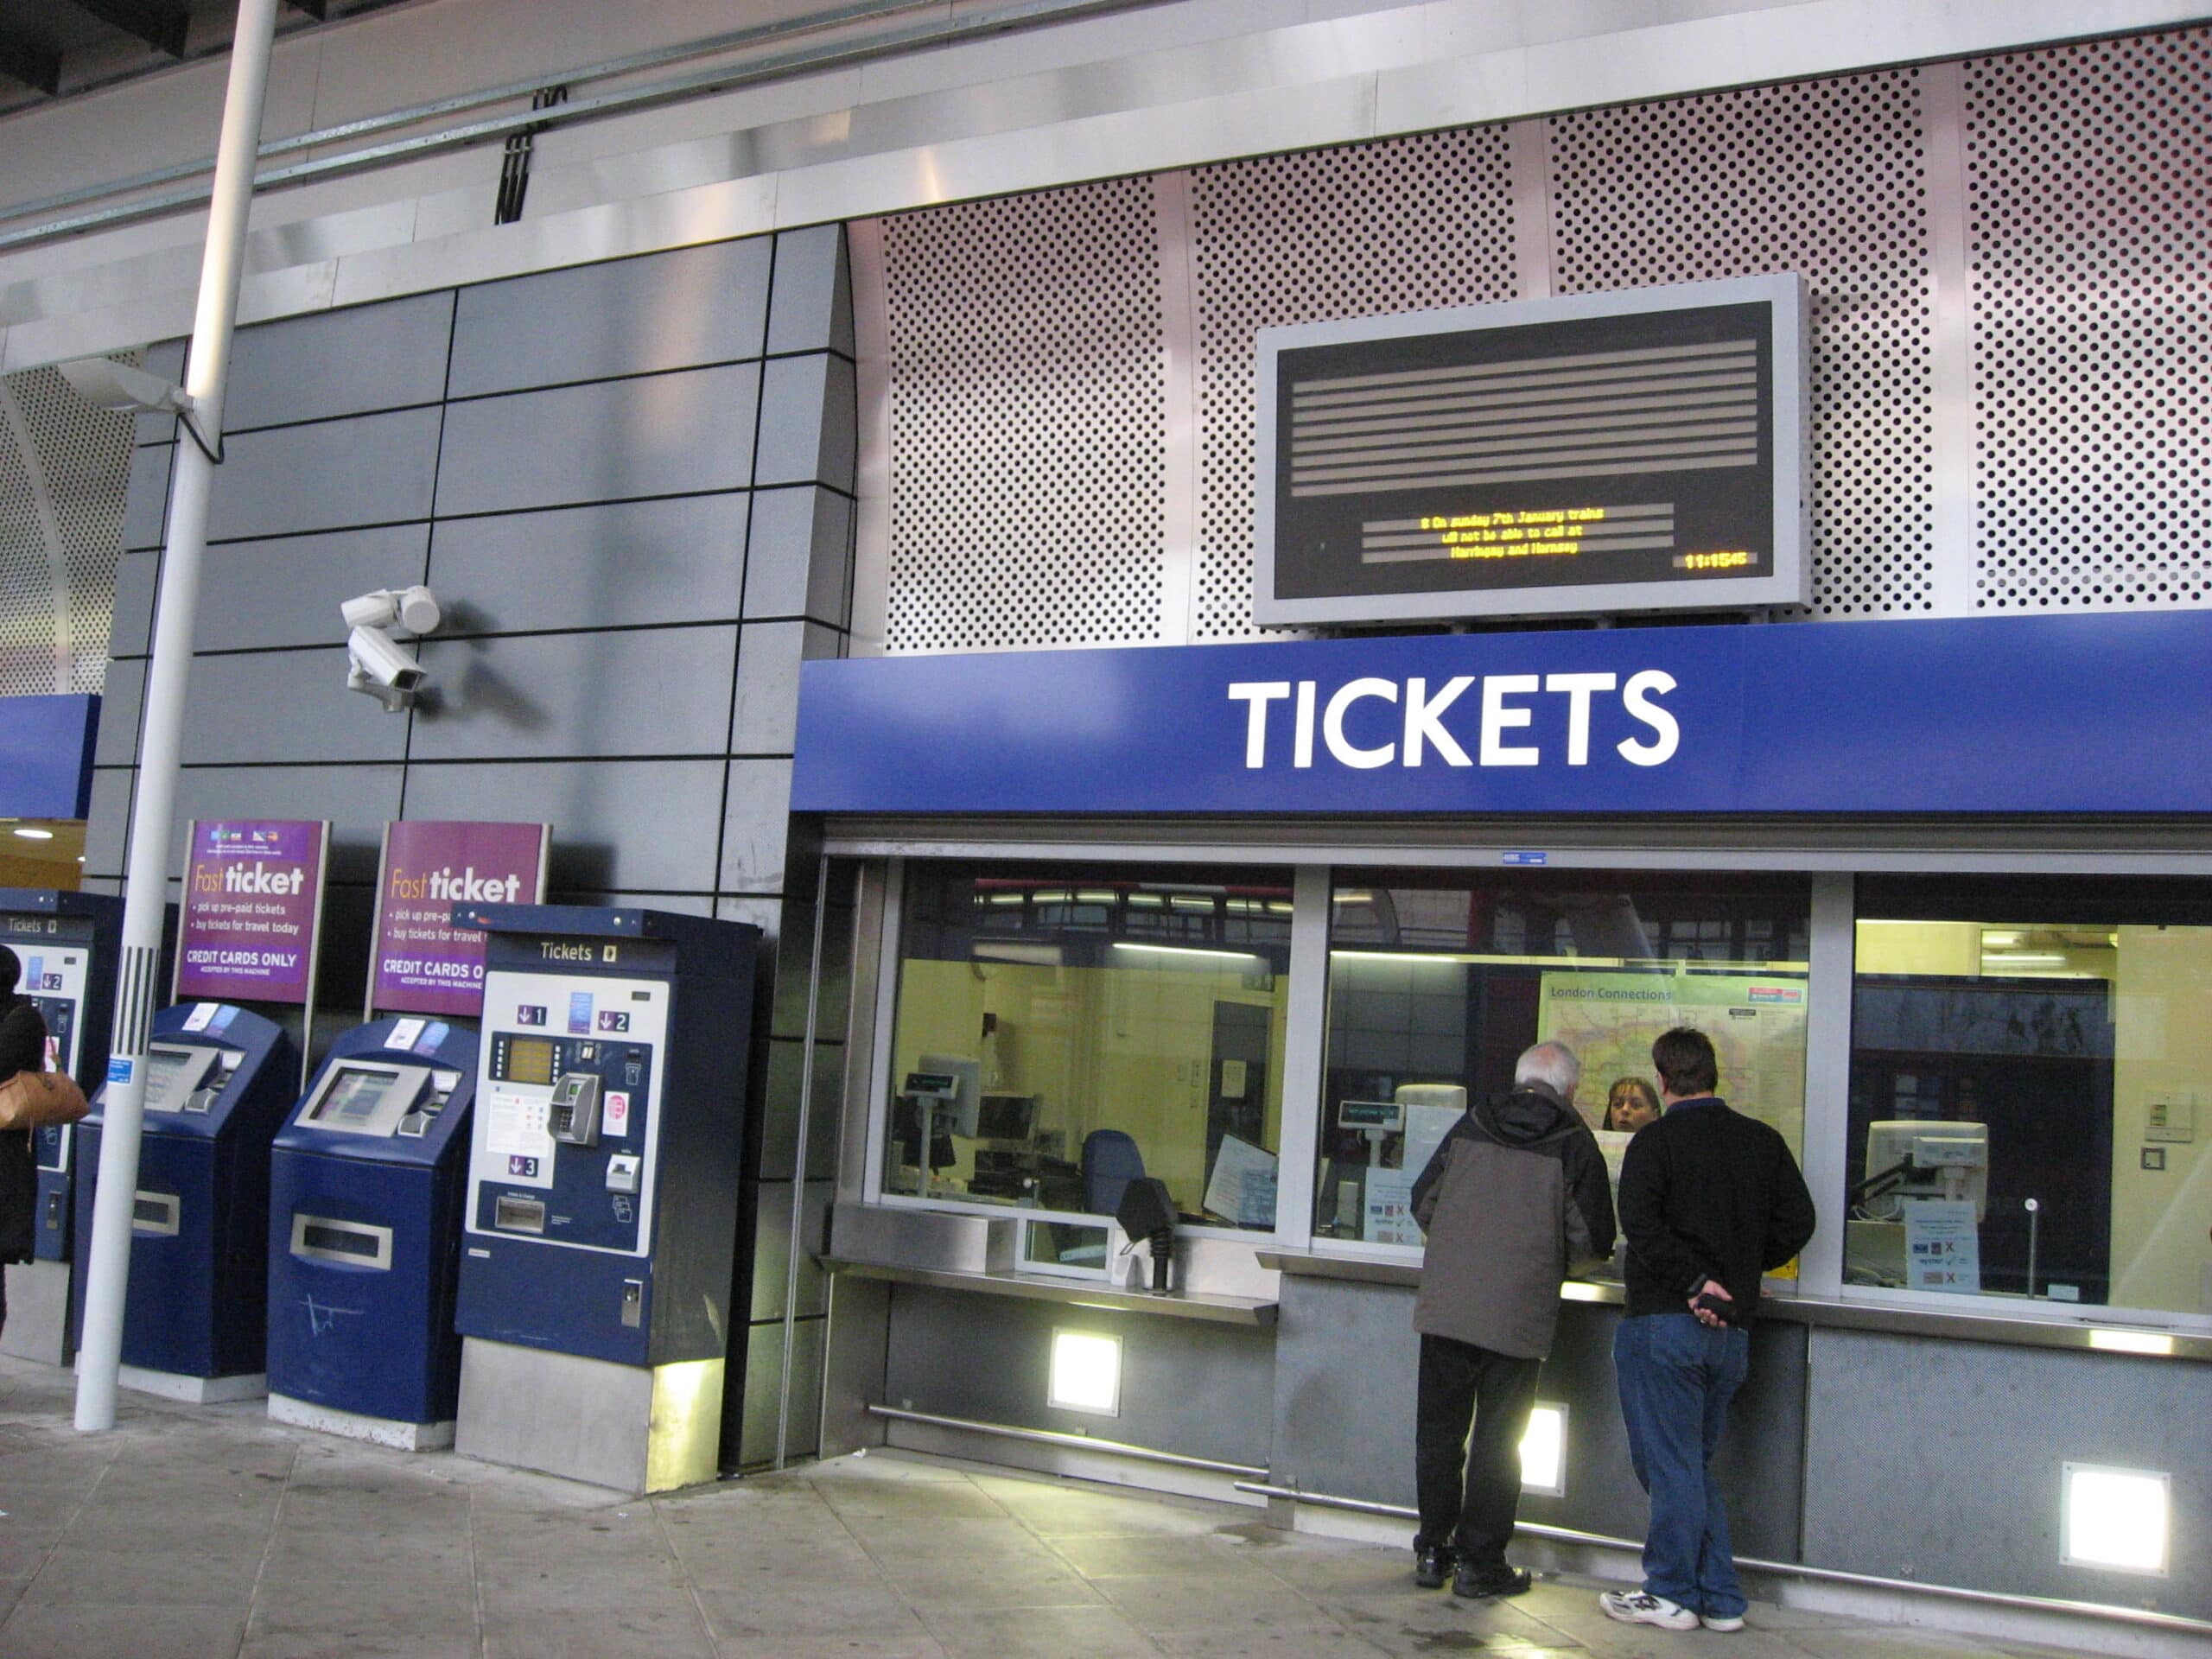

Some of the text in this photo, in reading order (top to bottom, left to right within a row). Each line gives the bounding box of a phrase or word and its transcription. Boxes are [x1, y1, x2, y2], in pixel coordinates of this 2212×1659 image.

[1517, 511, 1564, 524] January
[1567, 508, 1604, 521] trains
[1460, 531, 1480, 543] not
[1483, 530, 1497, 542] be
[1500, 528, 1523, 541] able
[1527, 528, 1541, 538] to
[1544, 525, 1564, 537] call
[1567, 525, 1583, 537] at
[1507, 543, 1529, 556] and
[1229, 670, 1680, 768] TICKETS
[194, 861, 304, 895] Fast ticket
[391, 867, 520, 903] Fast ticket
[219, 903, 252, 914] pre-paid
[255, 904, 285, 915] tickets
[395, 908, 410, 920] pick
[412, 911, 422, 922] up
[8, 918, 41, 933] Tickets
[196, 919, 299, 935] buy tickets for travel today
[393, 929, 406, 941] buy
[408, 929, 435, 940] tickets
[438, 929, 451, 941] for
[454, 930, 482, 943] travel
[187, 950, 297, 968] CREDIT CARDS ONLY
[541, 942, 592, 962] Tickets
[383, 959, 422, 974] CREDIT
[424, 961, 469, 978] CARDS
[53, 976, 60, 988] 2
[400, 976, 483, 989] ACCEPTED BY THIS MACHINE
[1551, 987, 1671, 1001] London Connections
[536, 1008, 543, 1024] 1
[615, 1014, 626, 1031] 2
[525, 1159, 535, 1176] 3
